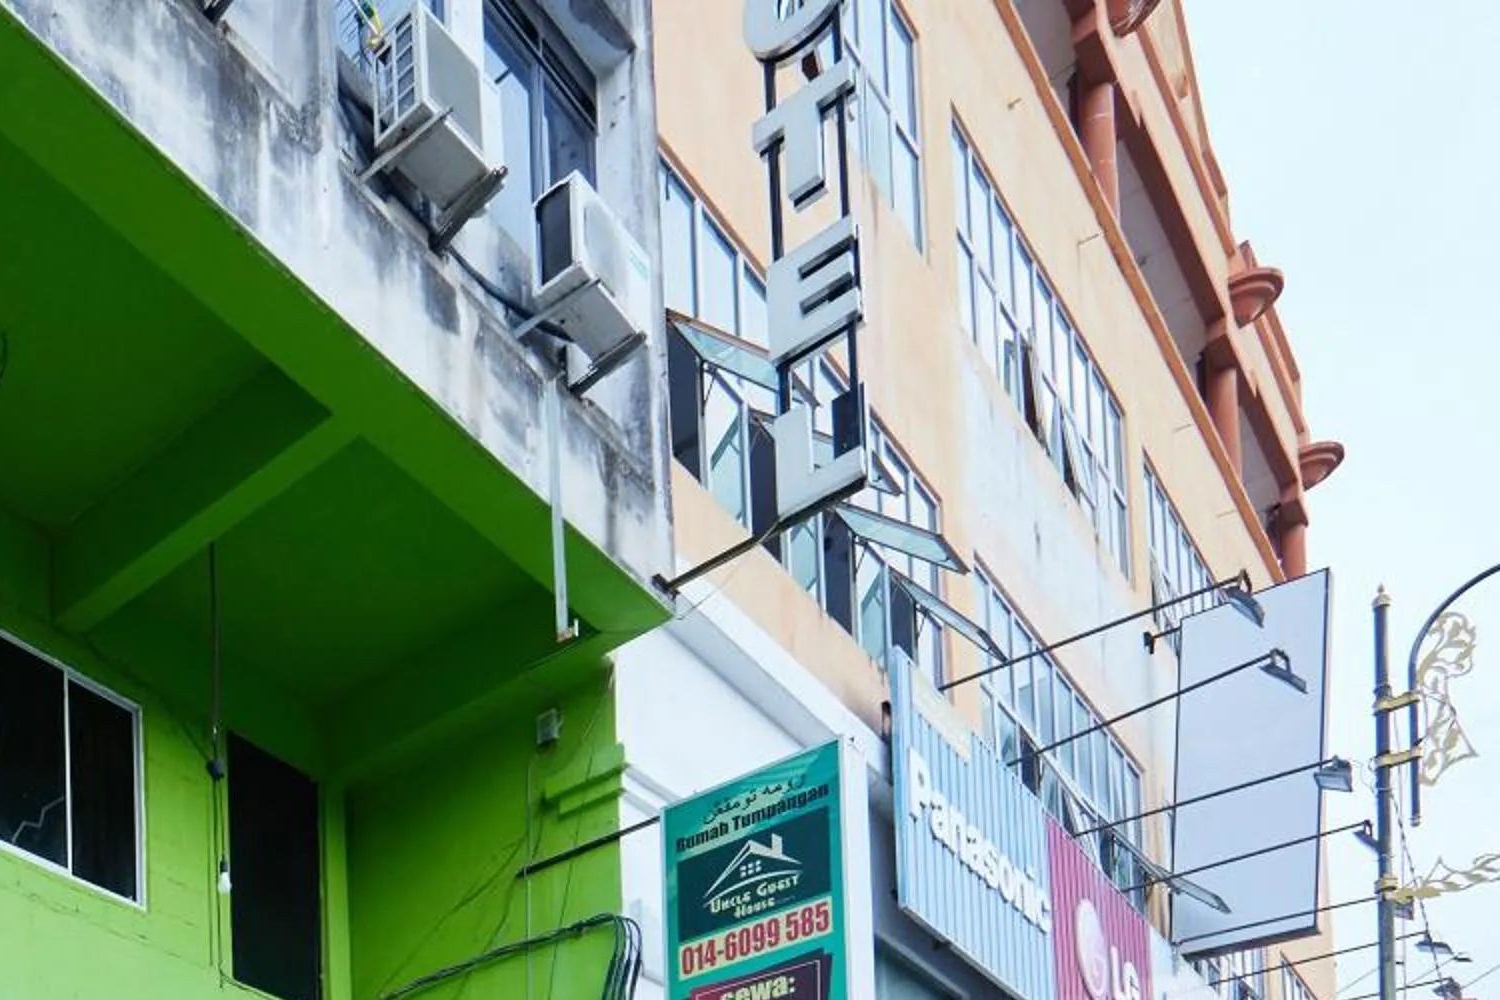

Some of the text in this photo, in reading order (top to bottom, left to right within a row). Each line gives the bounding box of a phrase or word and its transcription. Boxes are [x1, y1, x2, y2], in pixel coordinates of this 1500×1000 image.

[676, 783, 829, 852] Rumah Tumpangan
[907, 746, 1052, 936] Panasonic
[682, 901, 829, 975] 014-6099 585
